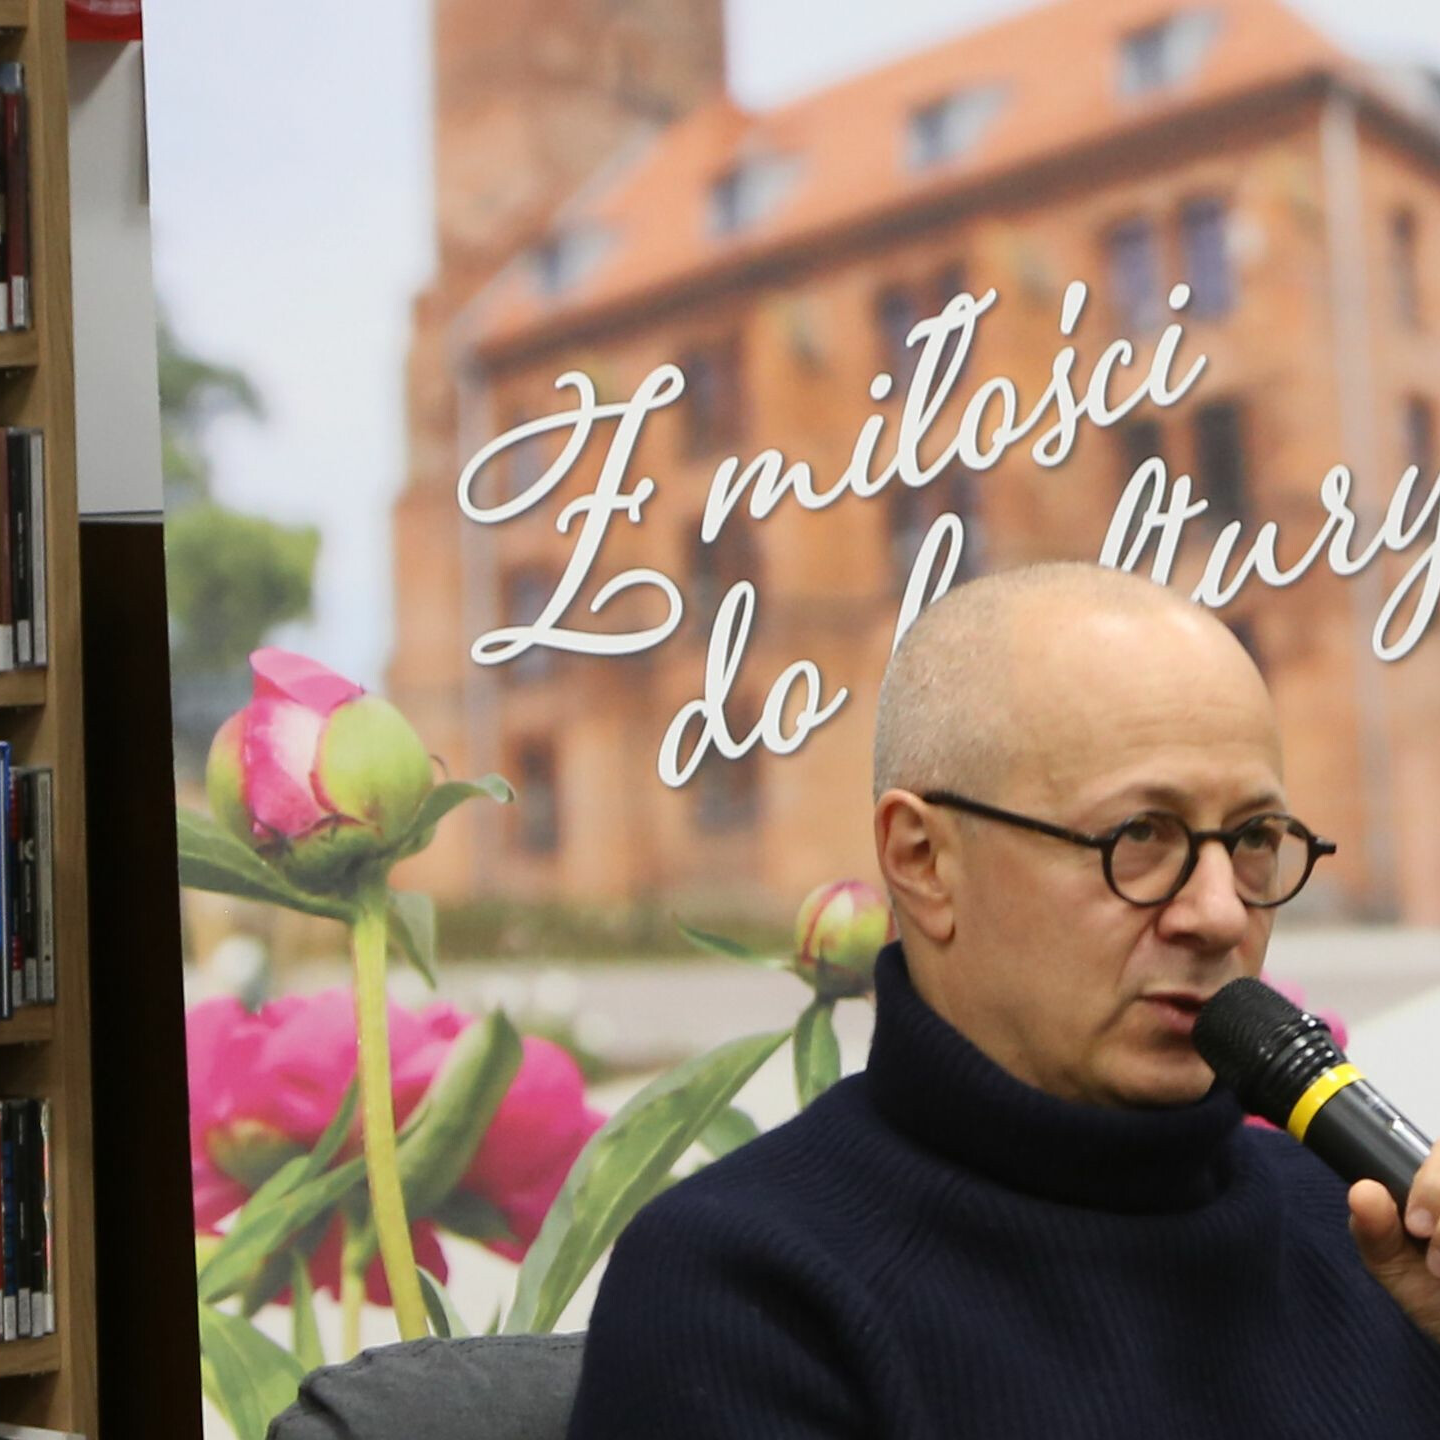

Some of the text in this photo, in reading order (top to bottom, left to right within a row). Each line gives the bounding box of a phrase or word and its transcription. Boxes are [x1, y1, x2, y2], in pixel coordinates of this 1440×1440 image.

[457, 280, 1207, 664] Z miłości
[657, 579, 848, 788] do
